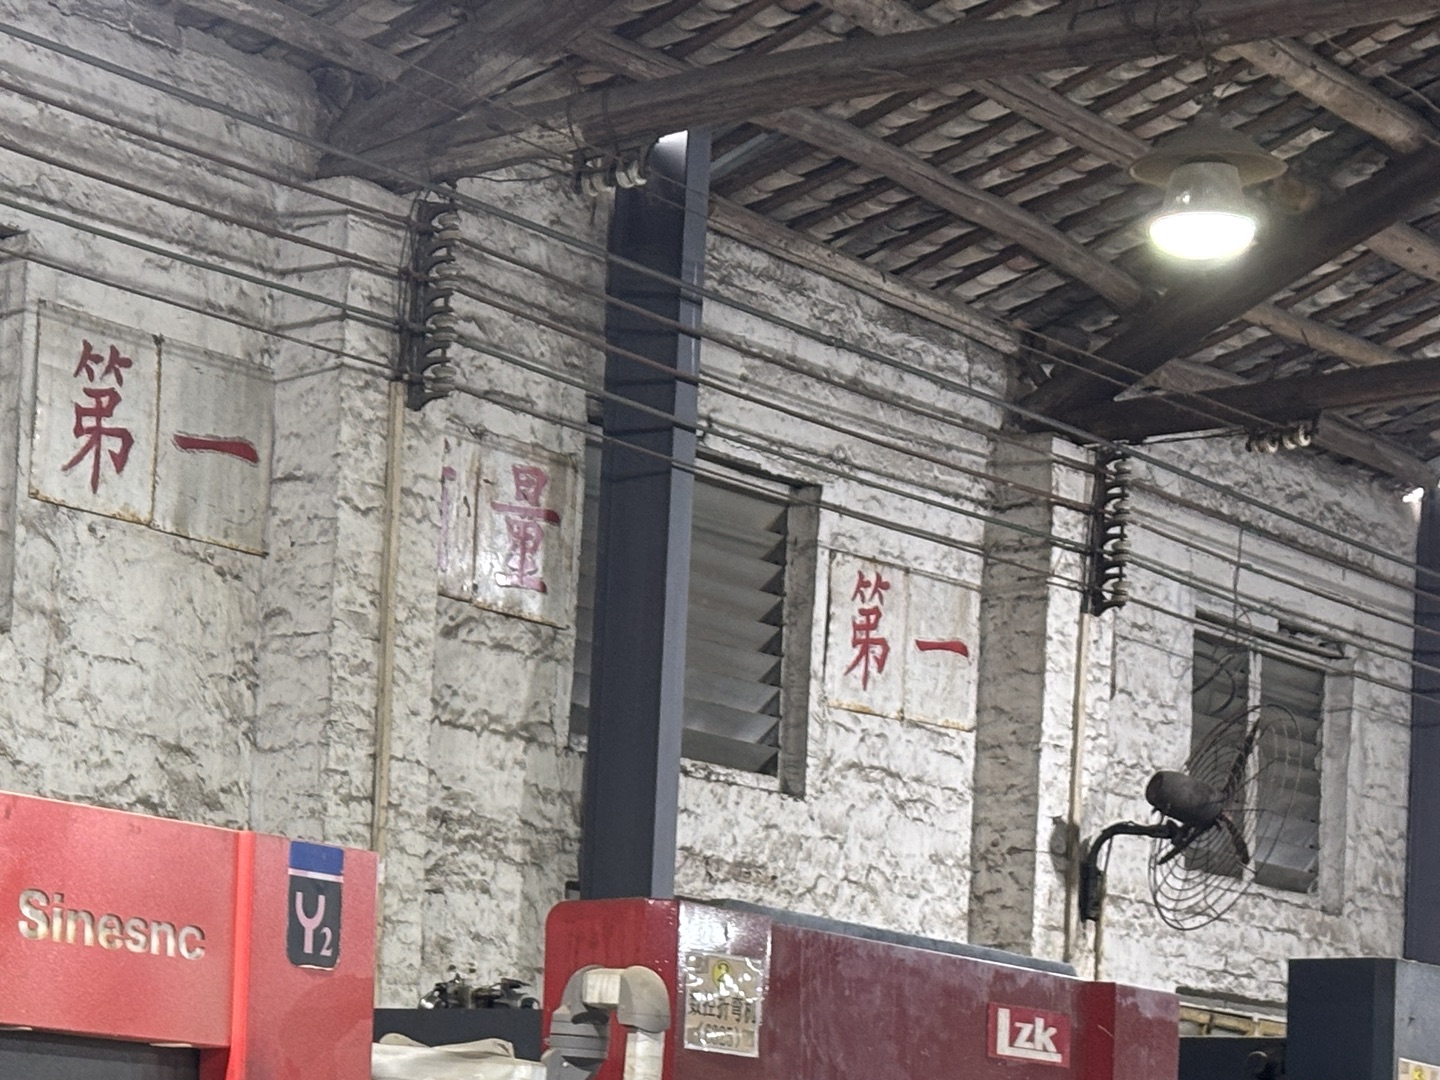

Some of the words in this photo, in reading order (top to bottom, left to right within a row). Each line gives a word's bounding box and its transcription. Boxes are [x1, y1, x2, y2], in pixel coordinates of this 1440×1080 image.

[63, 339, 259, 494] 第一
[844, 569, 969, 692] 第一
[18, 888, 206, 960] Sinesnc
[295, 890, 333, 957] Y2
